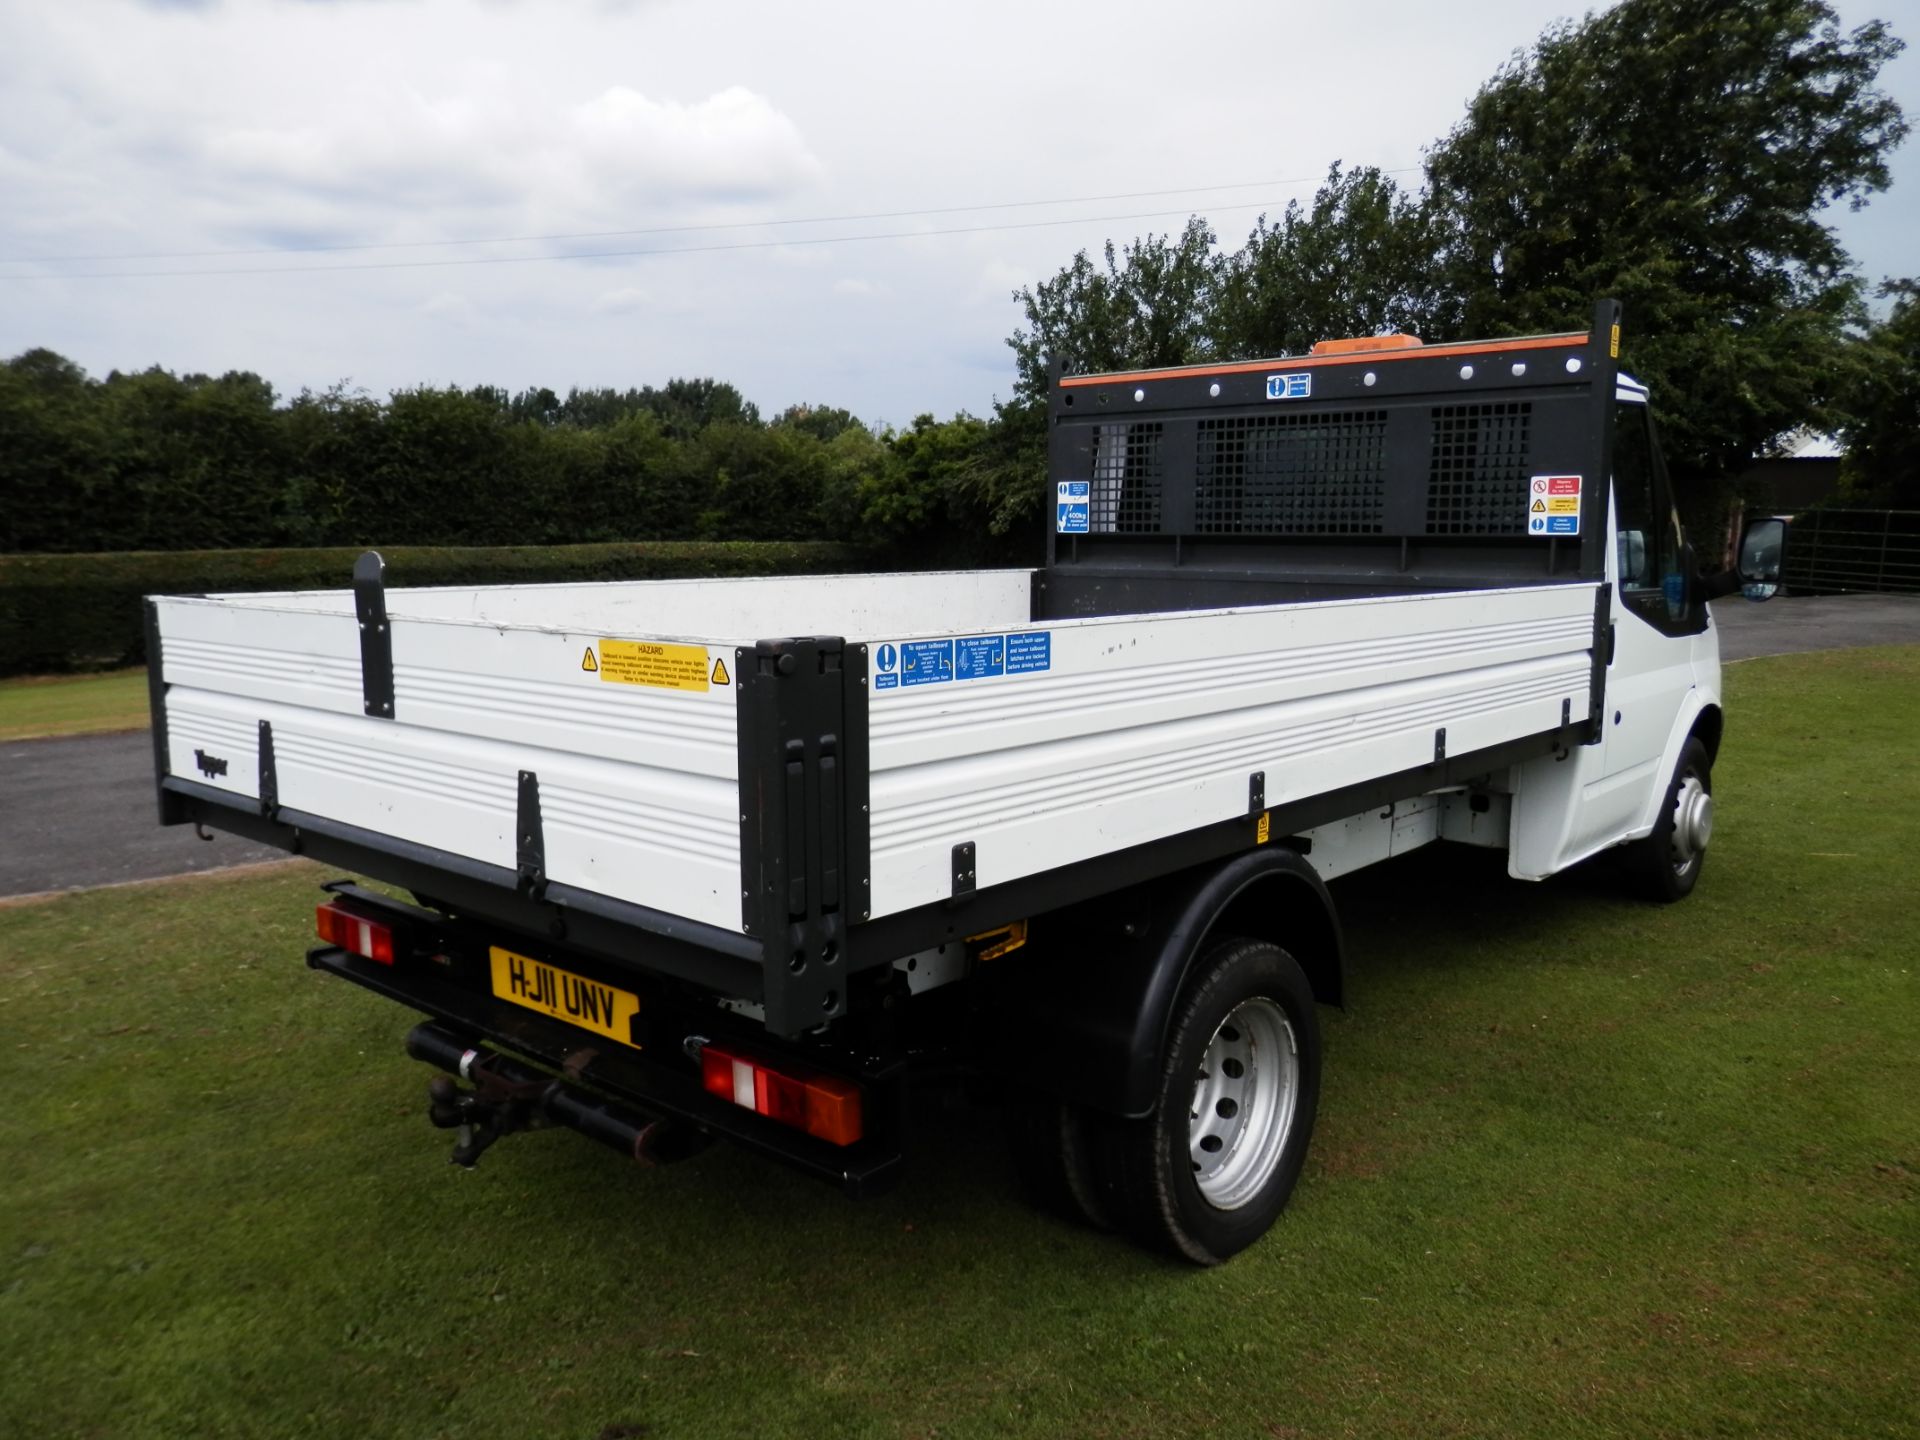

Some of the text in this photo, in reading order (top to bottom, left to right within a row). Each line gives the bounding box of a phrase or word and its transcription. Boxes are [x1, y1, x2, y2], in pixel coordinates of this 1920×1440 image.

[638, 645, 664, 655] HAZARD
[509, 957, 614, 1029] HJ11 UNV
